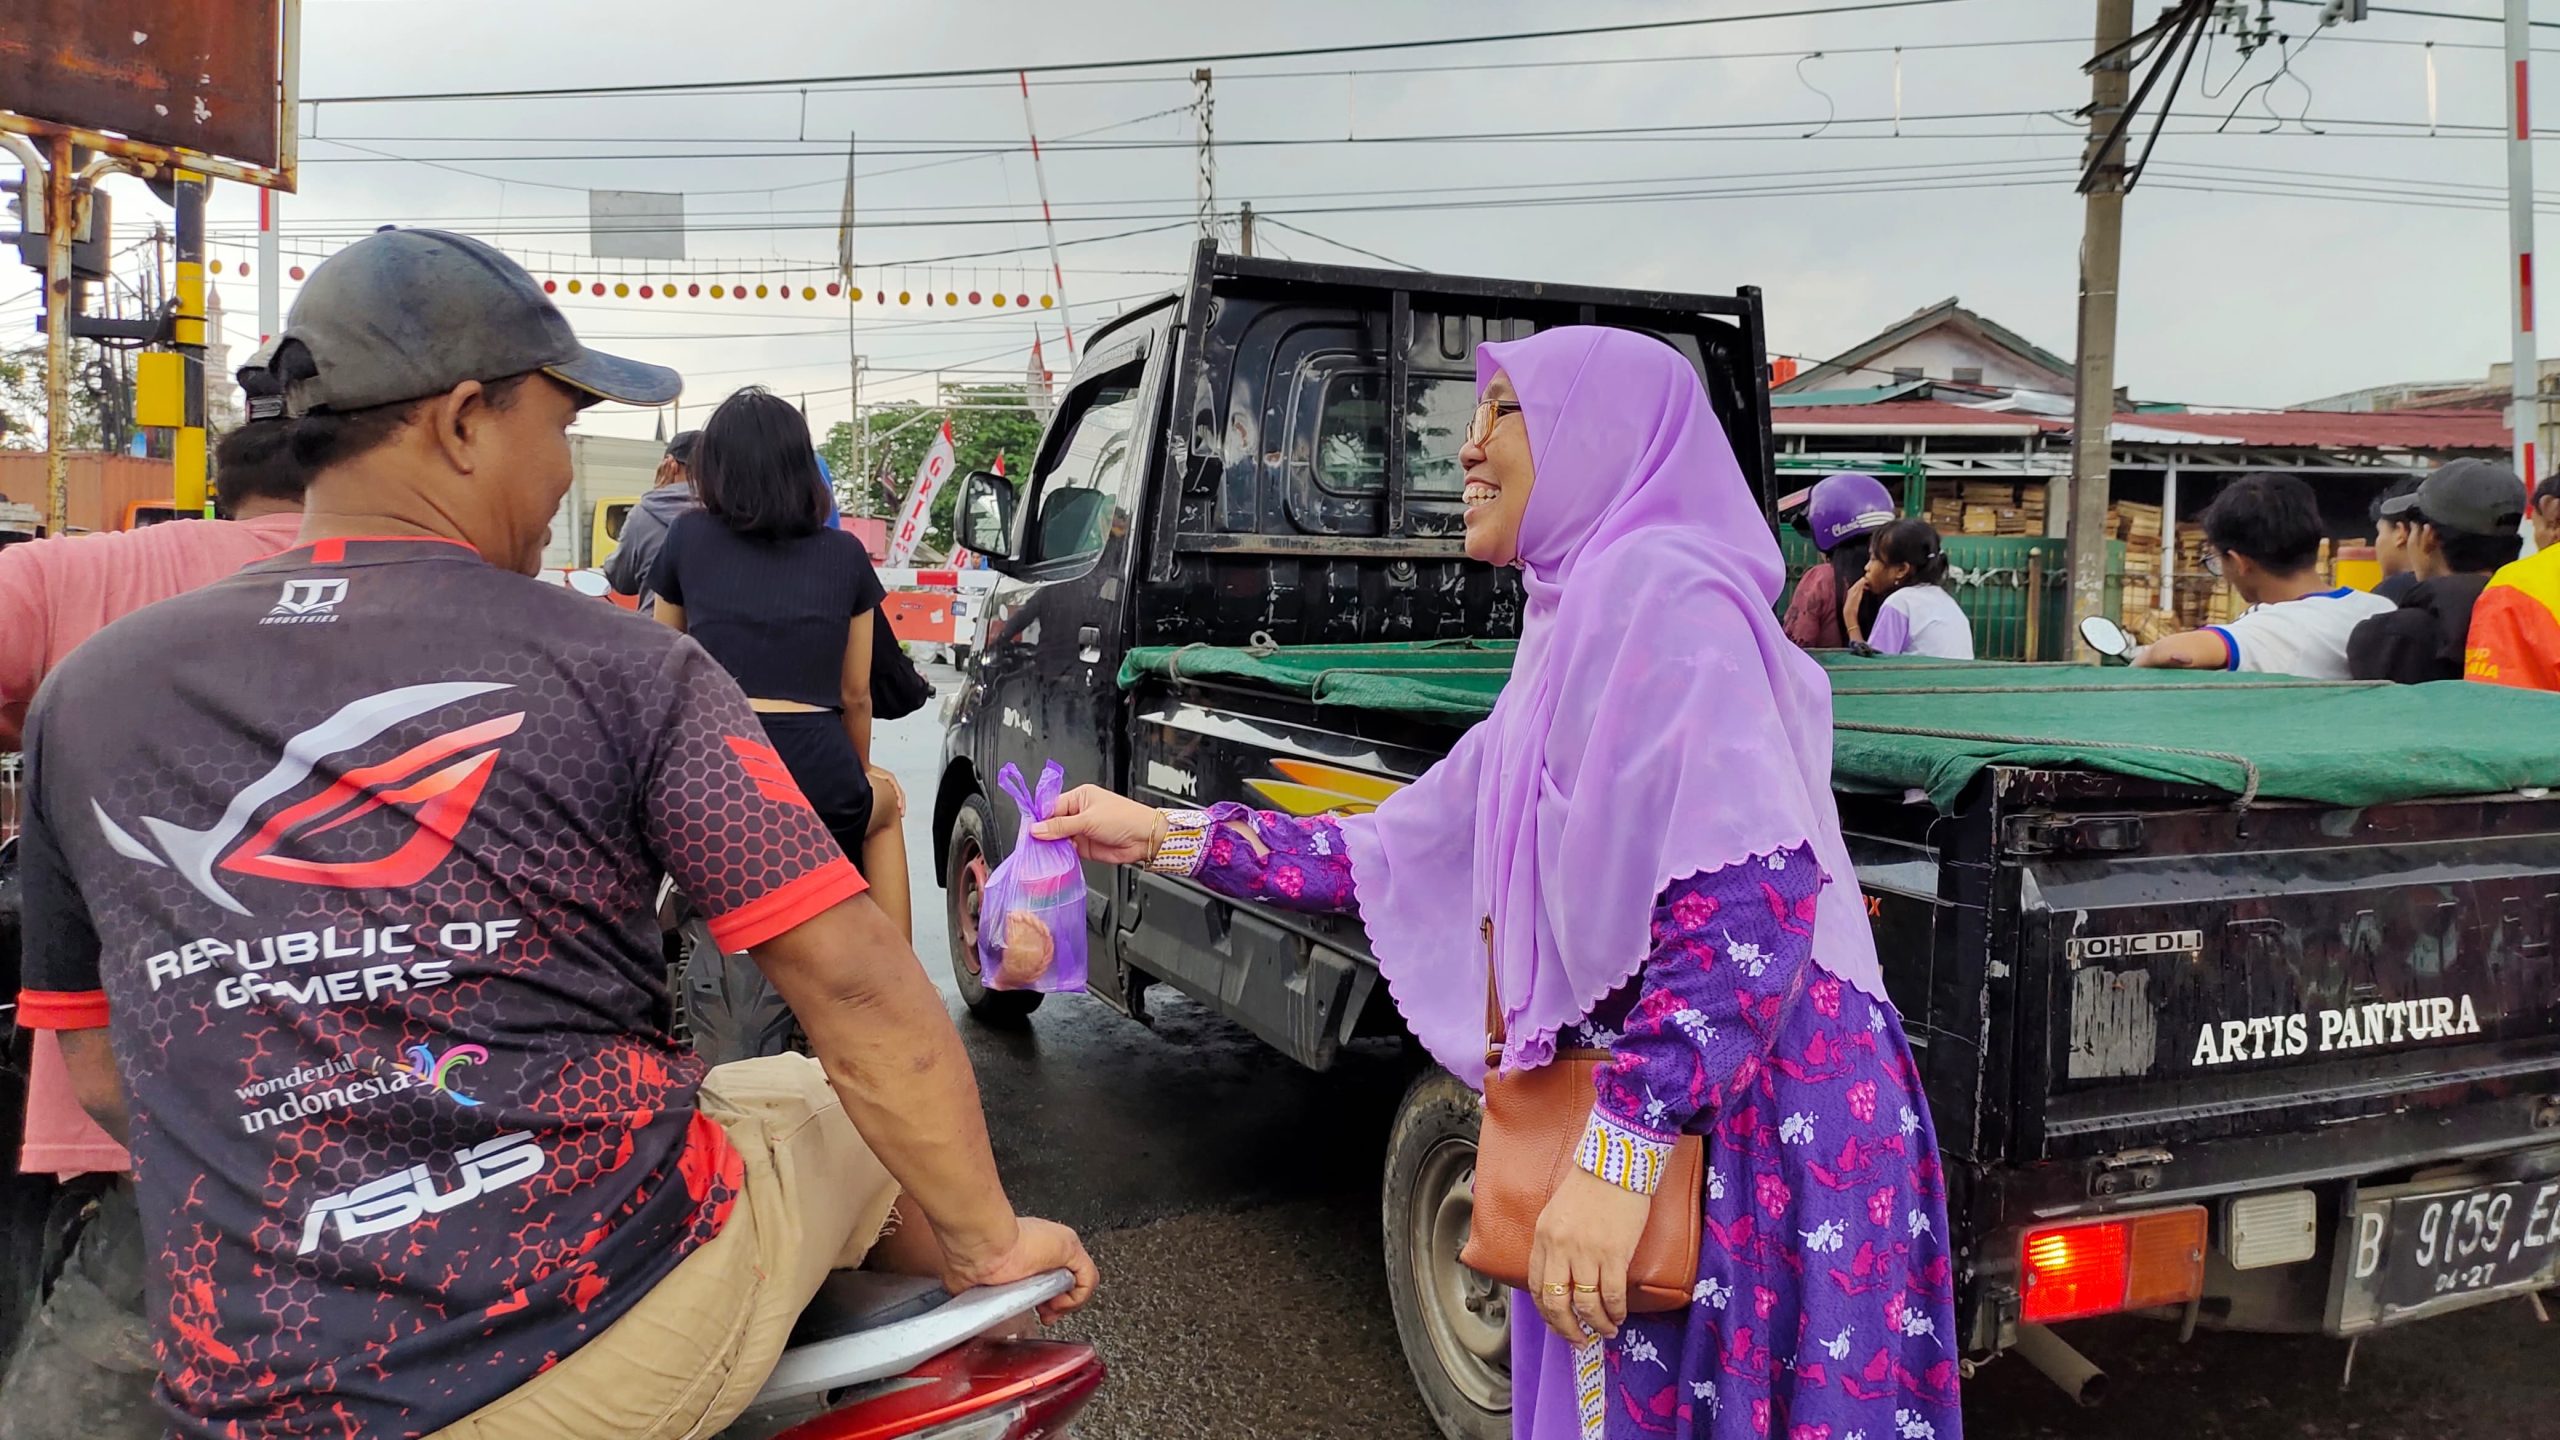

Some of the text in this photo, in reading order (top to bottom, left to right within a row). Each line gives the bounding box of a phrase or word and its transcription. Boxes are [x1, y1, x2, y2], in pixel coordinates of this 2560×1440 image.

[900, 456, 945, 542] GRIB
[258, 614, 340, 625] INDUSTRIES
[145, 918, 522, 992] REPUBLIC OF
[214, 960, 454, 1010] GAMERS
[2191, 994, 2481, 1066] ARTIS PANTURA
[234, 1053, 358, 1100] wonderful
[239, 1070, 413, 1134] indonesia
[296, 1129, 546, 1256] ASUS
[2354, 1212, 2385, 1279] B
[2415, 1192, 2513, 1267] 9159
